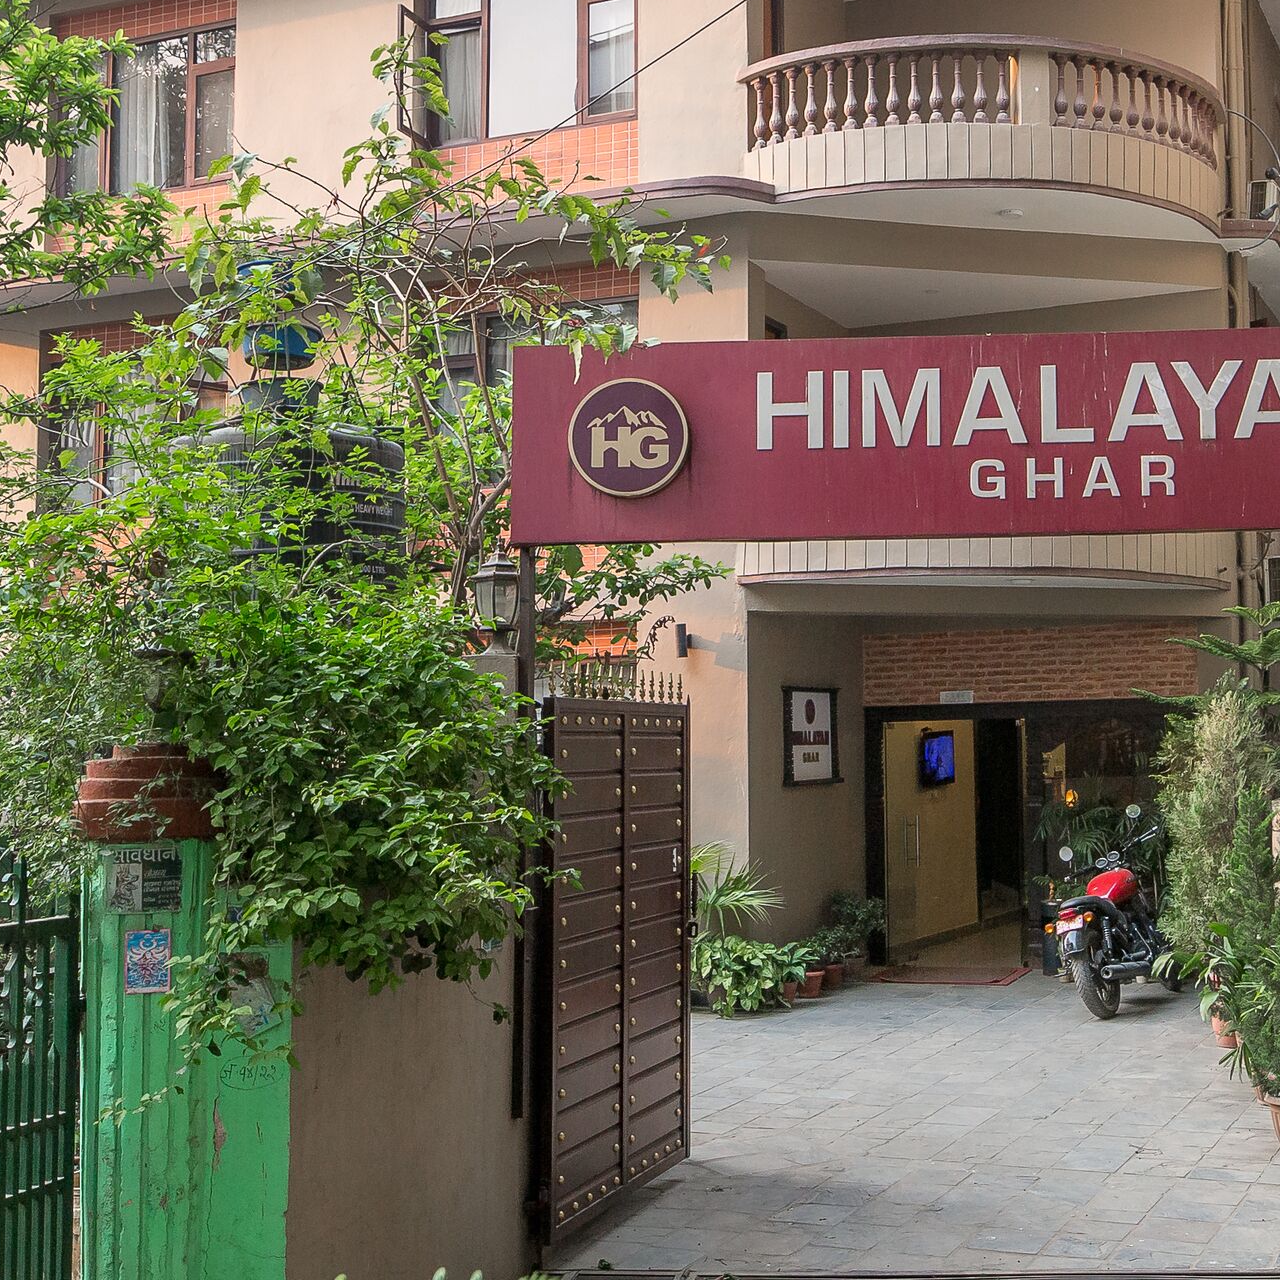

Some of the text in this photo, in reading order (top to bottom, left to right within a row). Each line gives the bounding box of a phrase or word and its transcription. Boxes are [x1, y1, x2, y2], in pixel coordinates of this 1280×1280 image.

[591, 426, 669, 469] HG
[969, 454, 1176, 499] GHAR
[113, 848, 177, 863] सावधान
